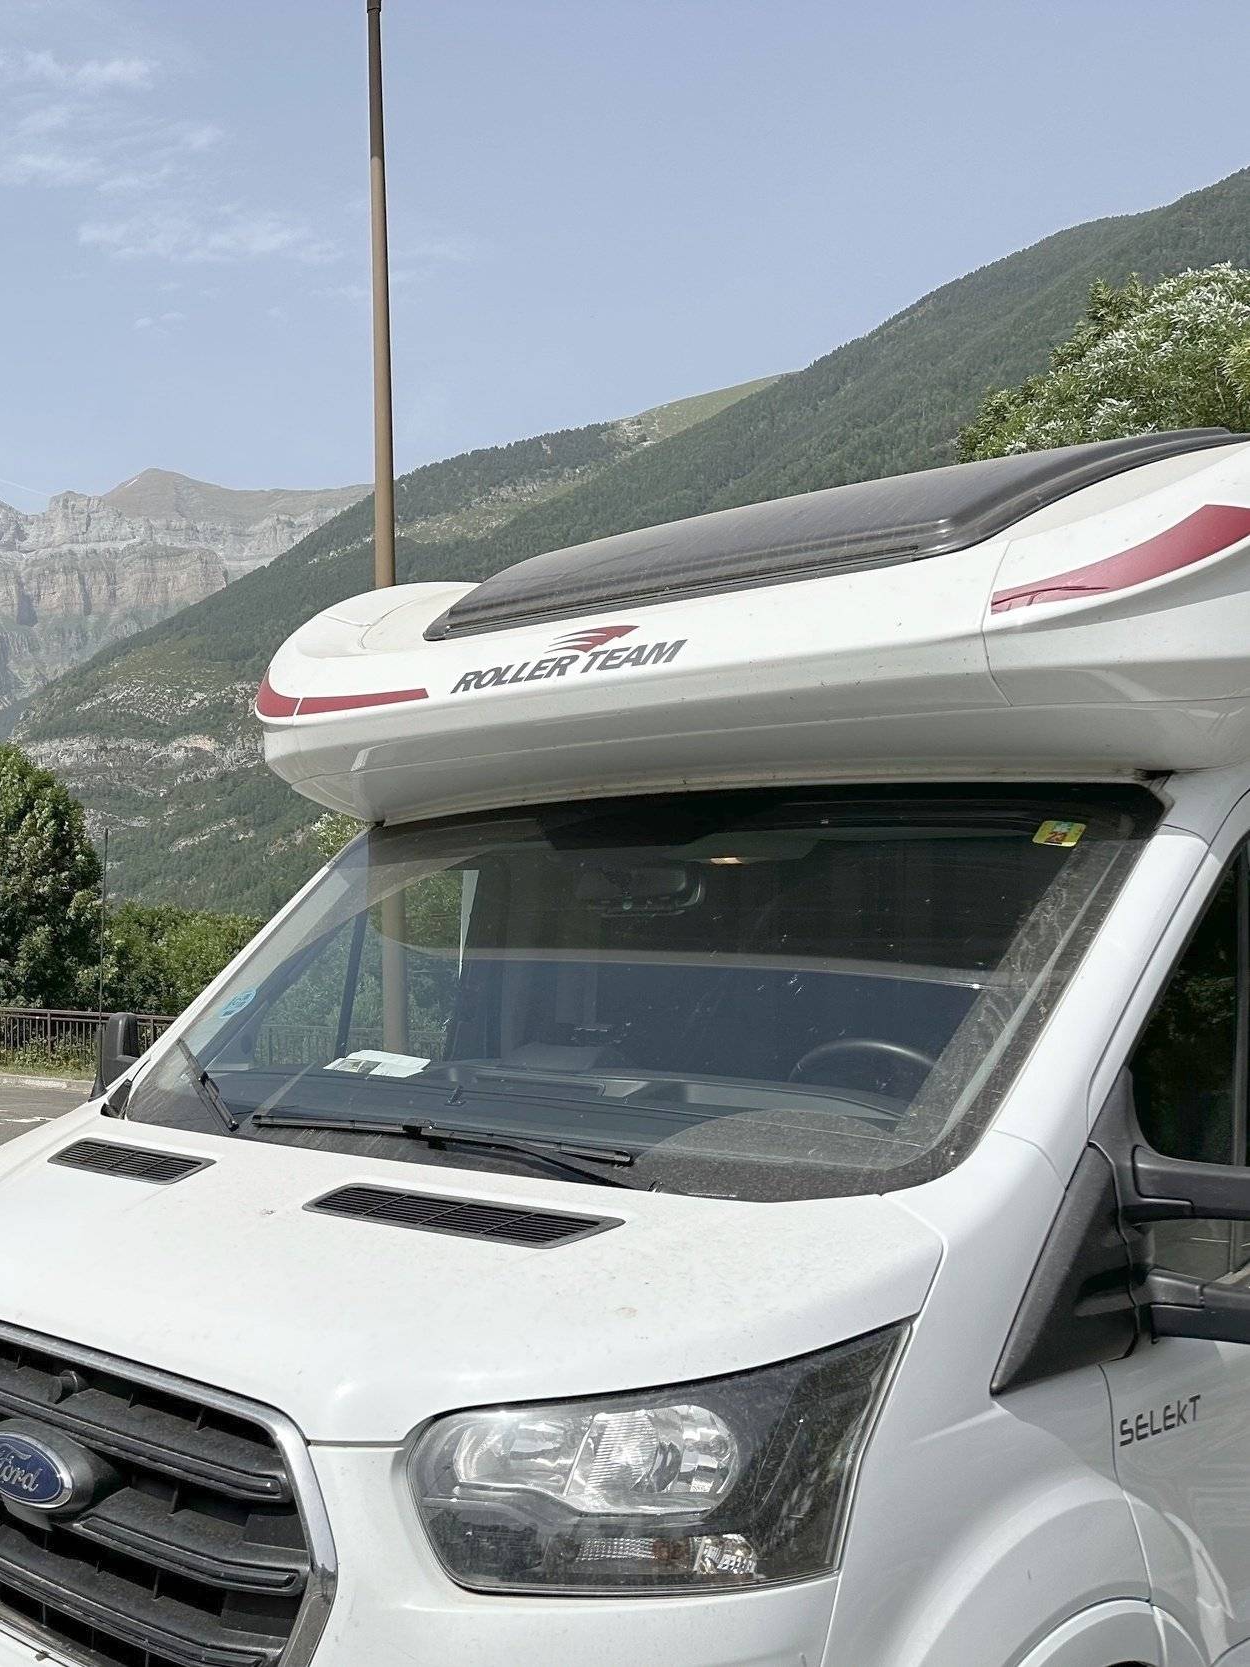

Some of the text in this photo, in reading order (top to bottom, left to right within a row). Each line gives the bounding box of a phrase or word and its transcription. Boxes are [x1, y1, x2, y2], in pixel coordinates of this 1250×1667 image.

[450, 639, 688, 694] ROLLER TEAM
[1119, 1394, 1201, 1447] SELEKT
